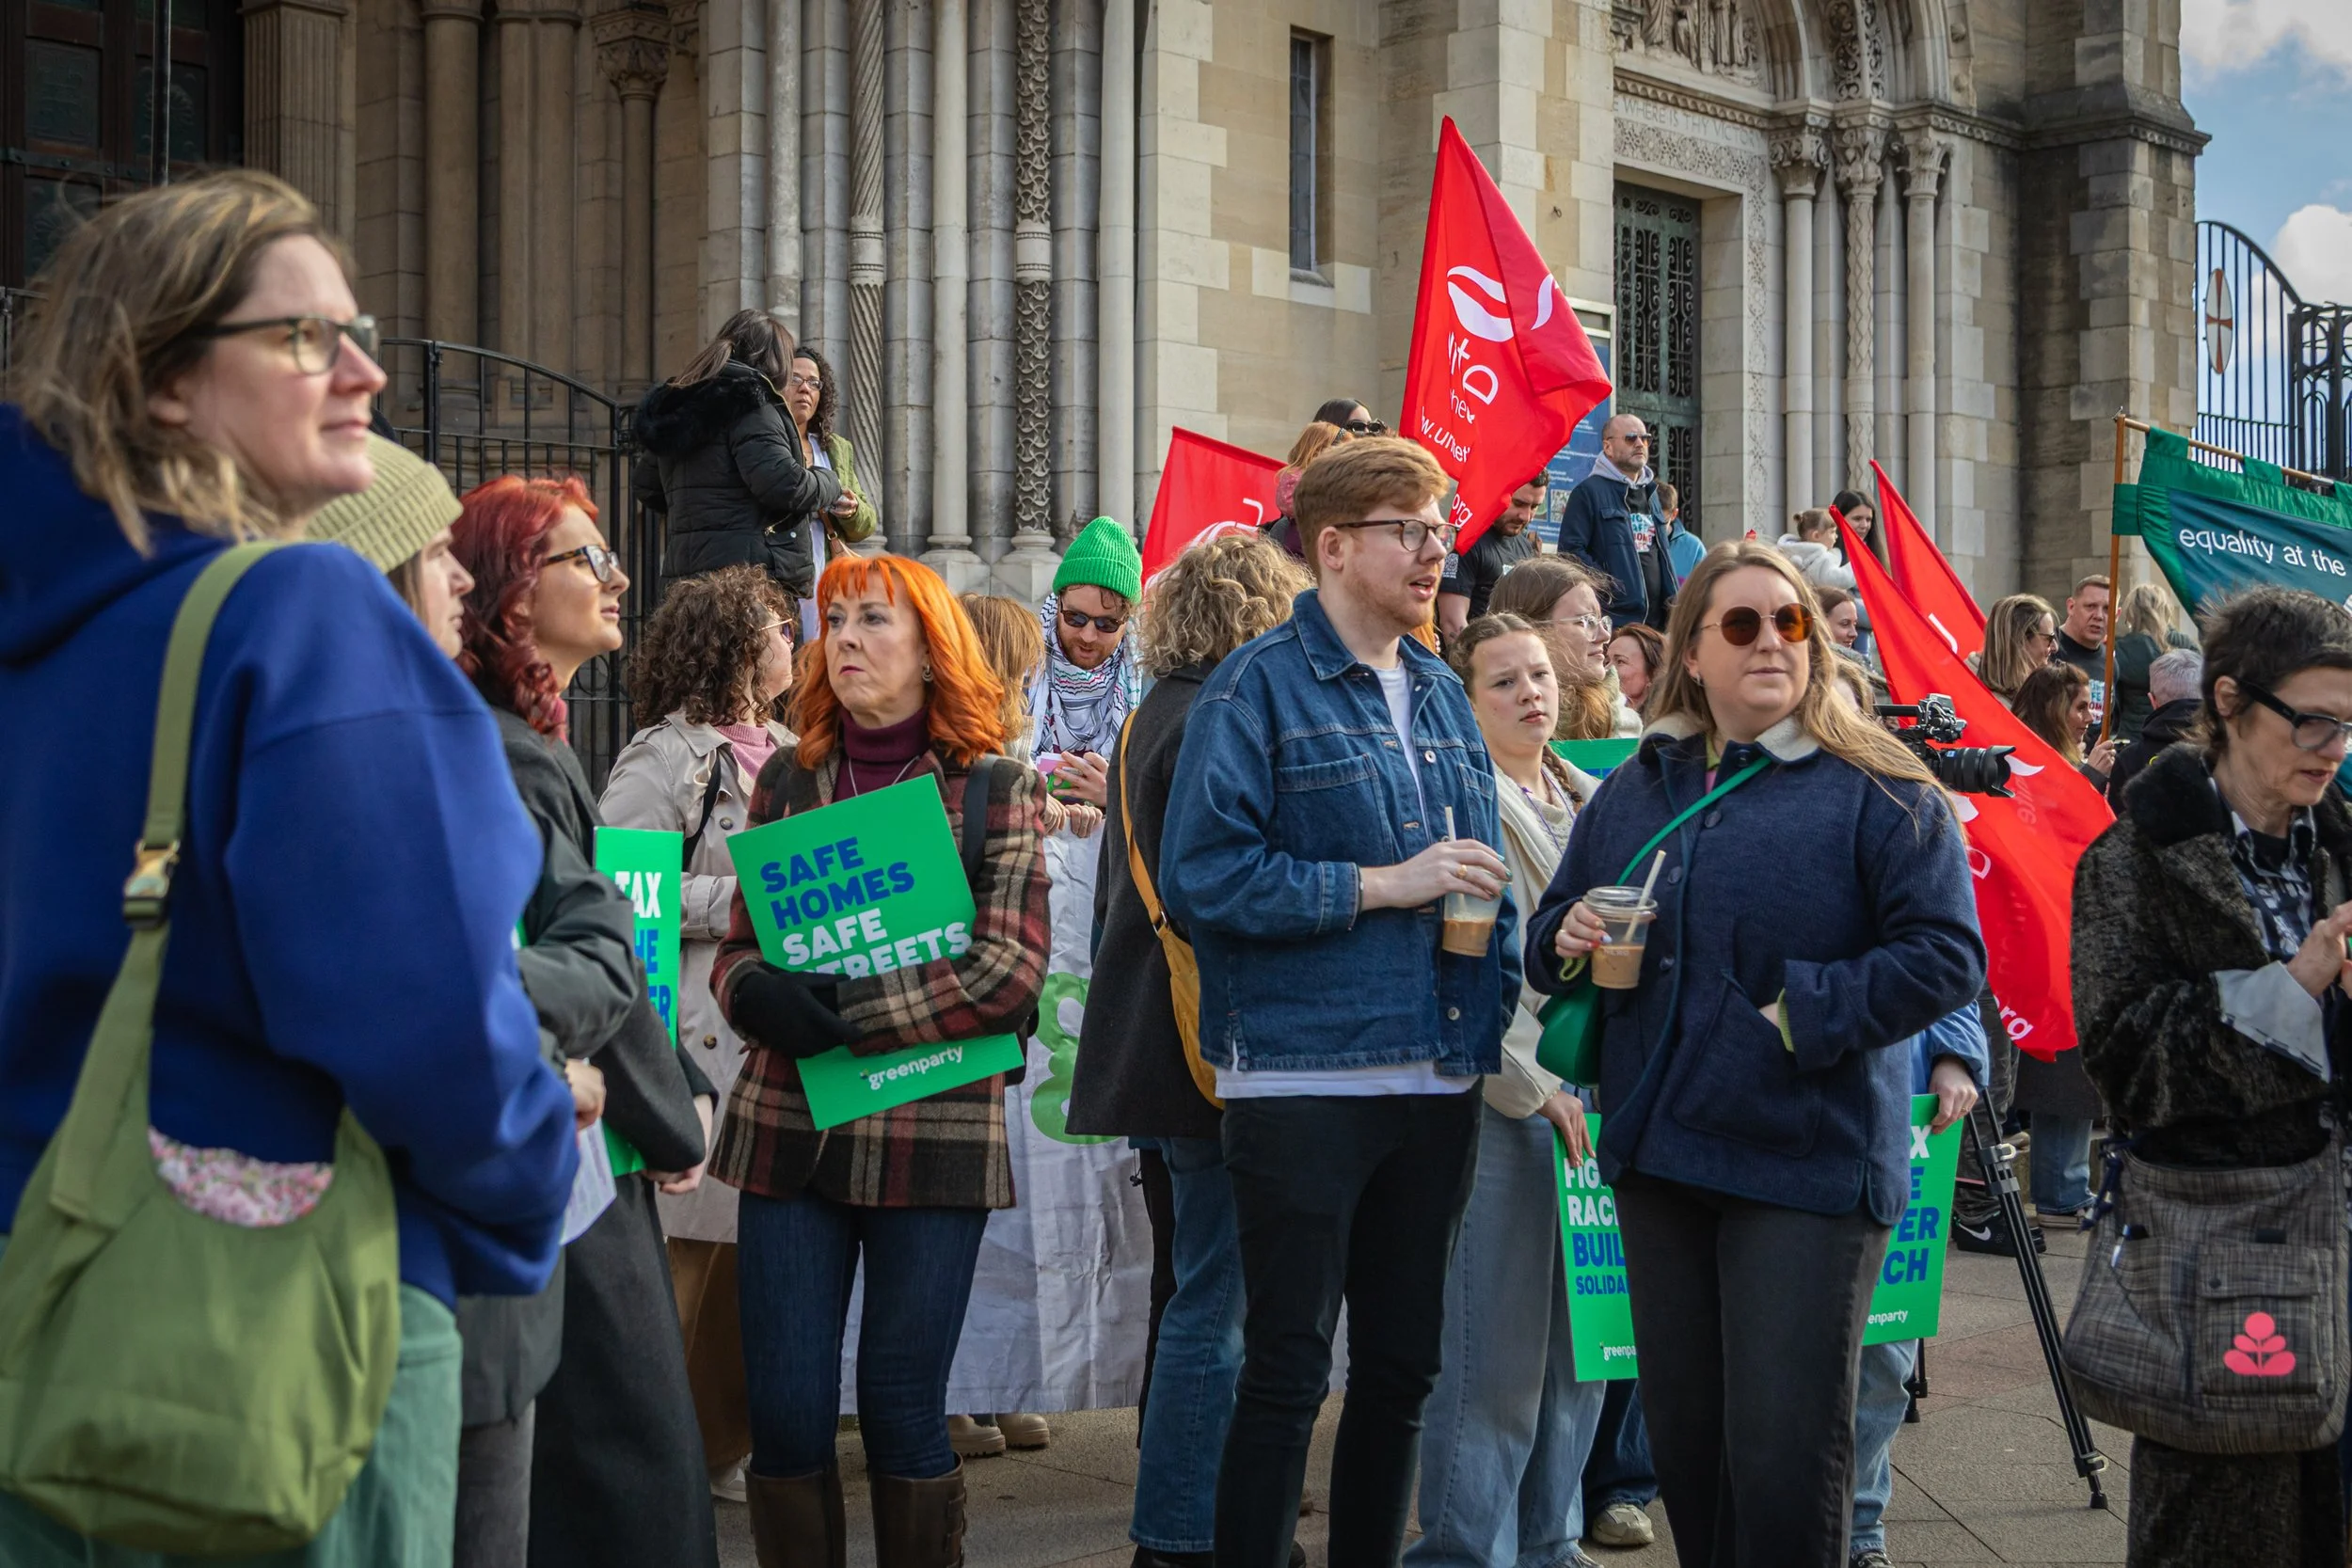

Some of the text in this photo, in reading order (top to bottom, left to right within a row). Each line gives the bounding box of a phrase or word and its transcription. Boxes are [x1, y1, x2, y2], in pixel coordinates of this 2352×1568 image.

[1624, 96, 1666, 125] WHERE
[1669, 110, 1679, 127] IS
[1682, 114, 1710, 135] THY
[2179, 529, 2346, 577] equality at the
[760, 836, 865, 894] SAFE
[614, 871, 662, 918] TAX
[770, 862, 915, 930] HOMES
[783, 908, 888, 966] SAFE
[803, 922, 973, 980] TREETS
[868, 1045, 963, 1090] greenparty
[1564, 1157, 1613, 1189] FIG
[1892, 1207, 1940, 1243] ER
[1876, 1247, 1930, 1287] CH
